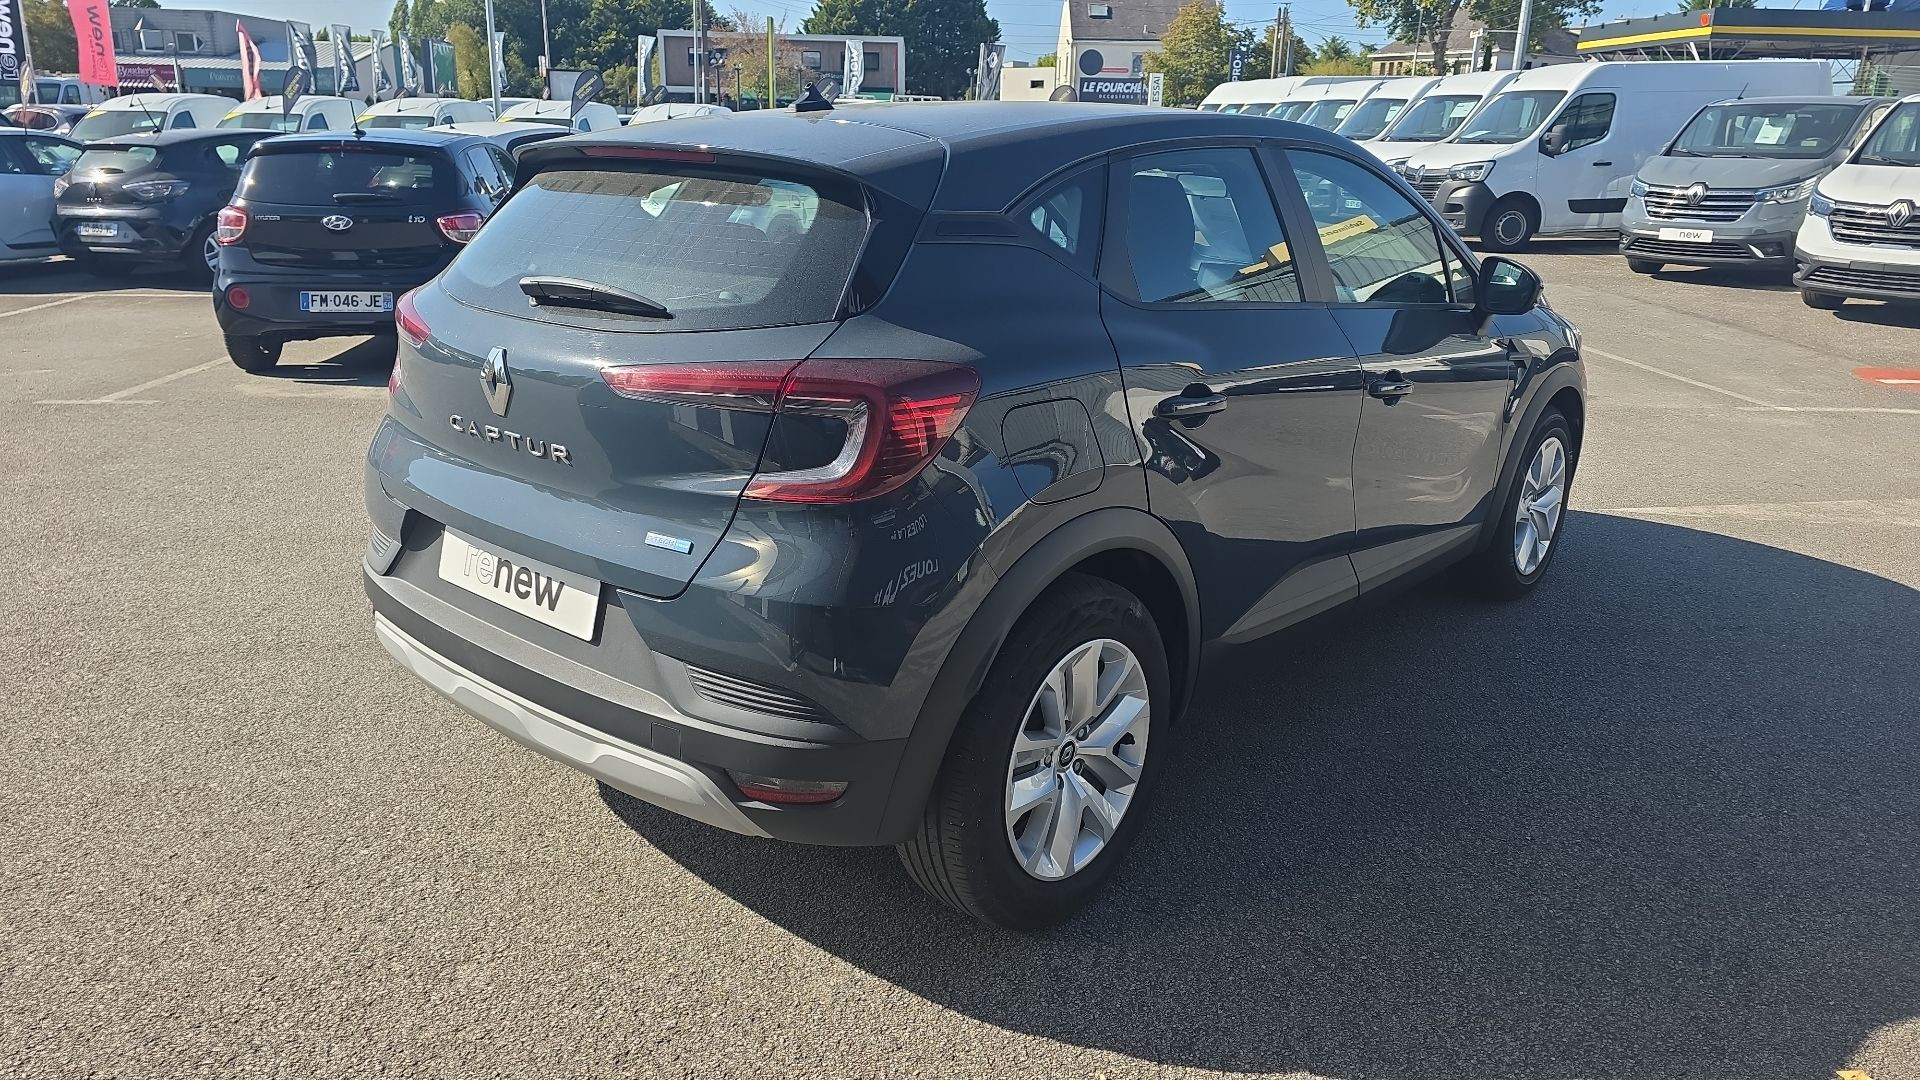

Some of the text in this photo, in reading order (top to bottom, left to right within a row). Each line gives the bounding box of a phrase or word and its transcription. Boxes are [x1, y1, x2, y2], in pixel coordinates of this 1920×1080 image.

[1082, 82, 1096, 93] LE
[1152, 76, 1161, 102] ESSAI
[310, 294, 382, 308] FM-046-JE
[449, 414, 574, 467] CAPTUR
[463, 543, 566, 612] renew
